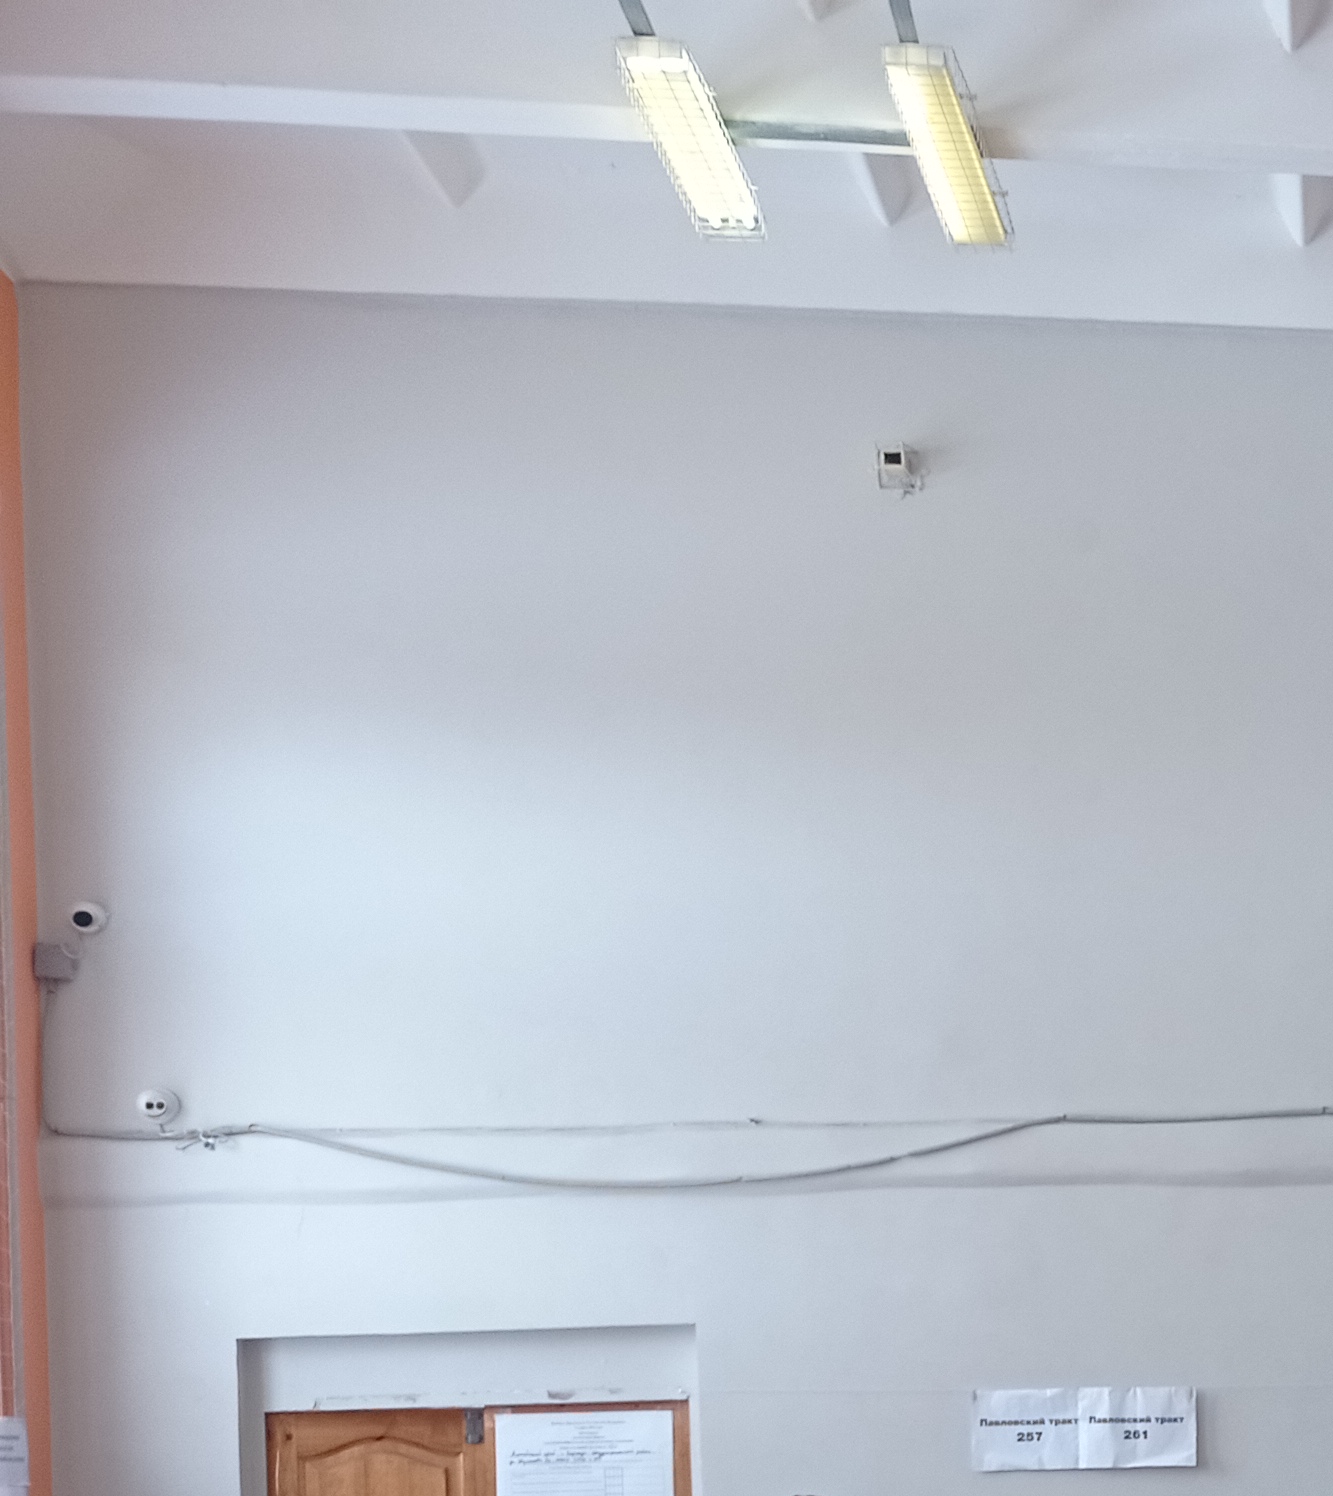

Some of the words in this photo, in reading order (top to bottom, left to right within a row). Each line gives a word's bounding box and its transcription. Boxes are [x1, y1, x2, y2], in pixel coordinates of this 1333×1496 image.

[979, 1417, 1046, 1428] Павловский
[1049, 1418, 1079, 1427] тракт
[1089, 1415, 1152, 1425] Павловский
[1154, 1416, 1185, 1425] тракт
[1016, 1431, 1043, 1443] 257
[1123, 1430, 1149, 1441] 261
